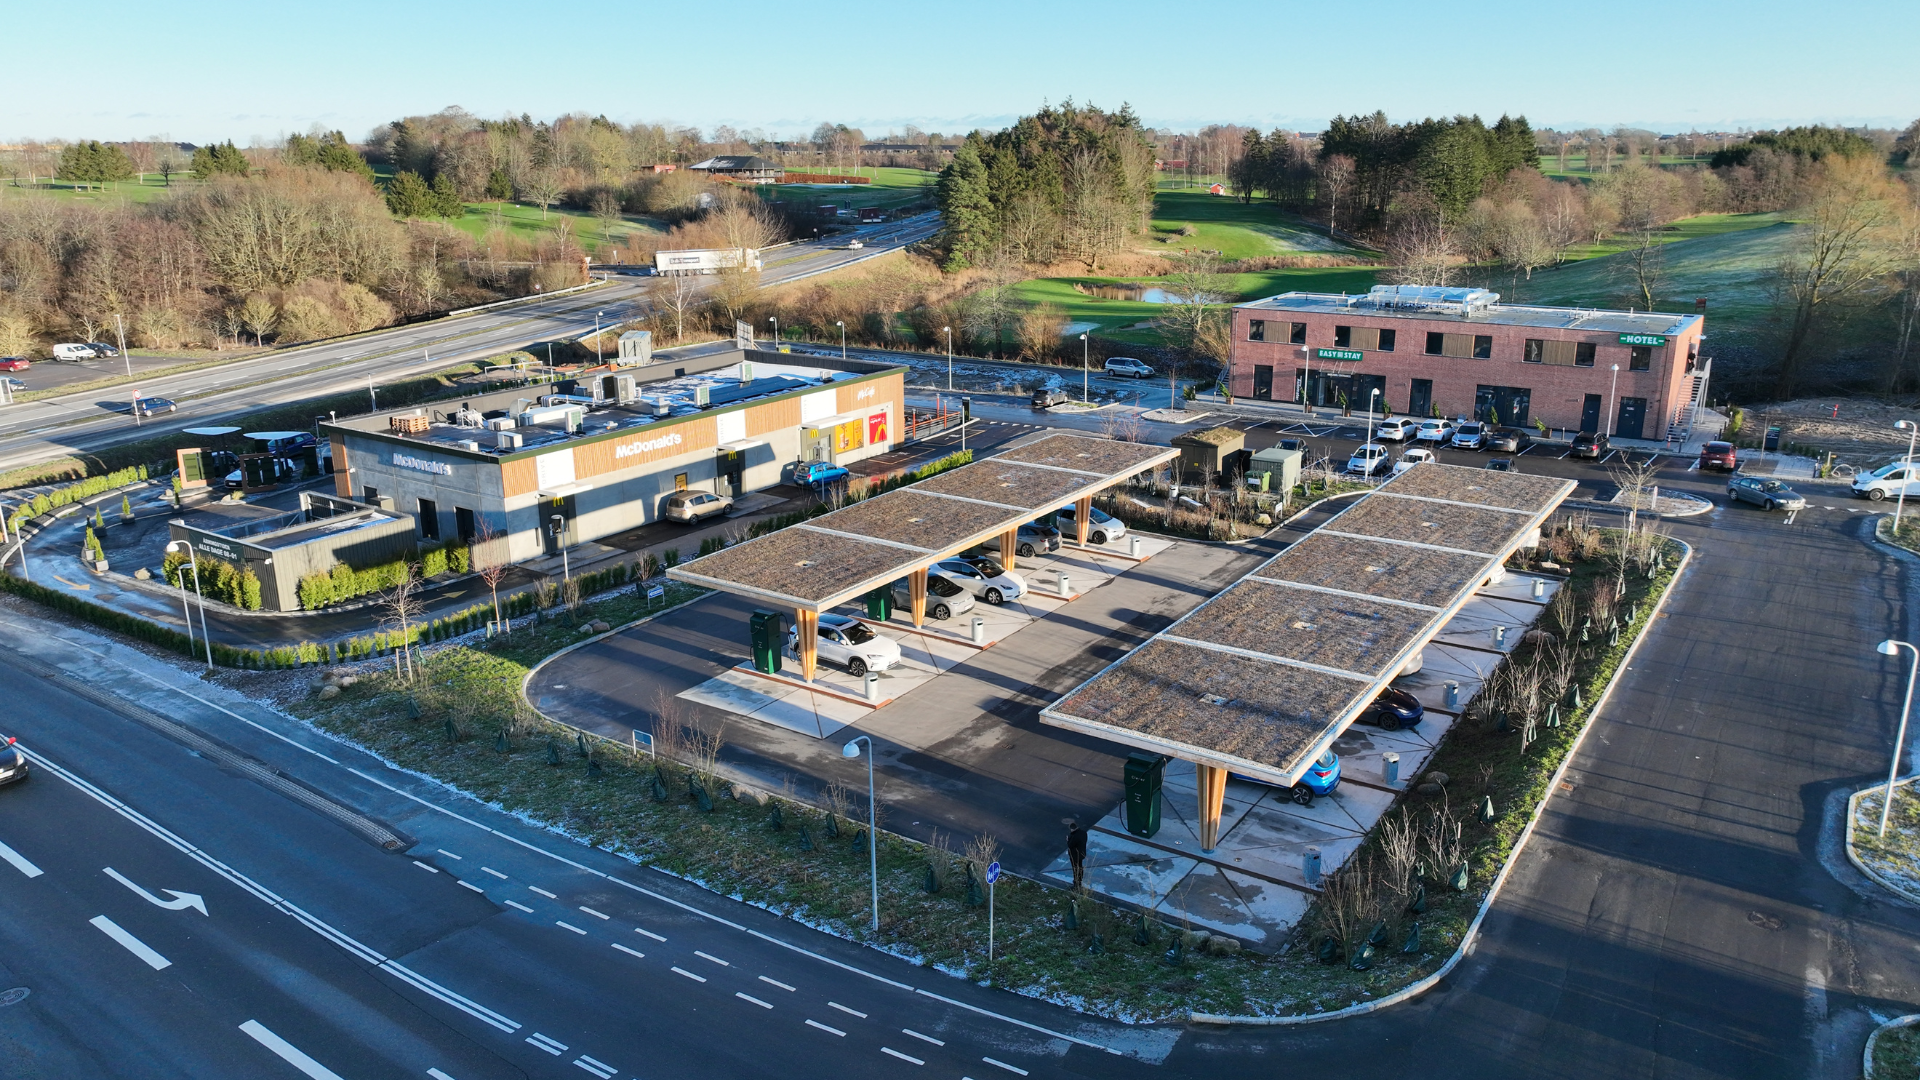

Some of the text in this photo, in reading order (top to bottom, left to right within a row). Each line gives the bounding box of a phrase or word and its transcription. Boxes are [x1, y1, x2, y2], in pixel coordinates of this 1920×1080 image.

[1319, 350, 1361, 360] EASY STAY
[615, 433, 682, 459] McDonald's
[393, 452, 451, 476] McDonald's
